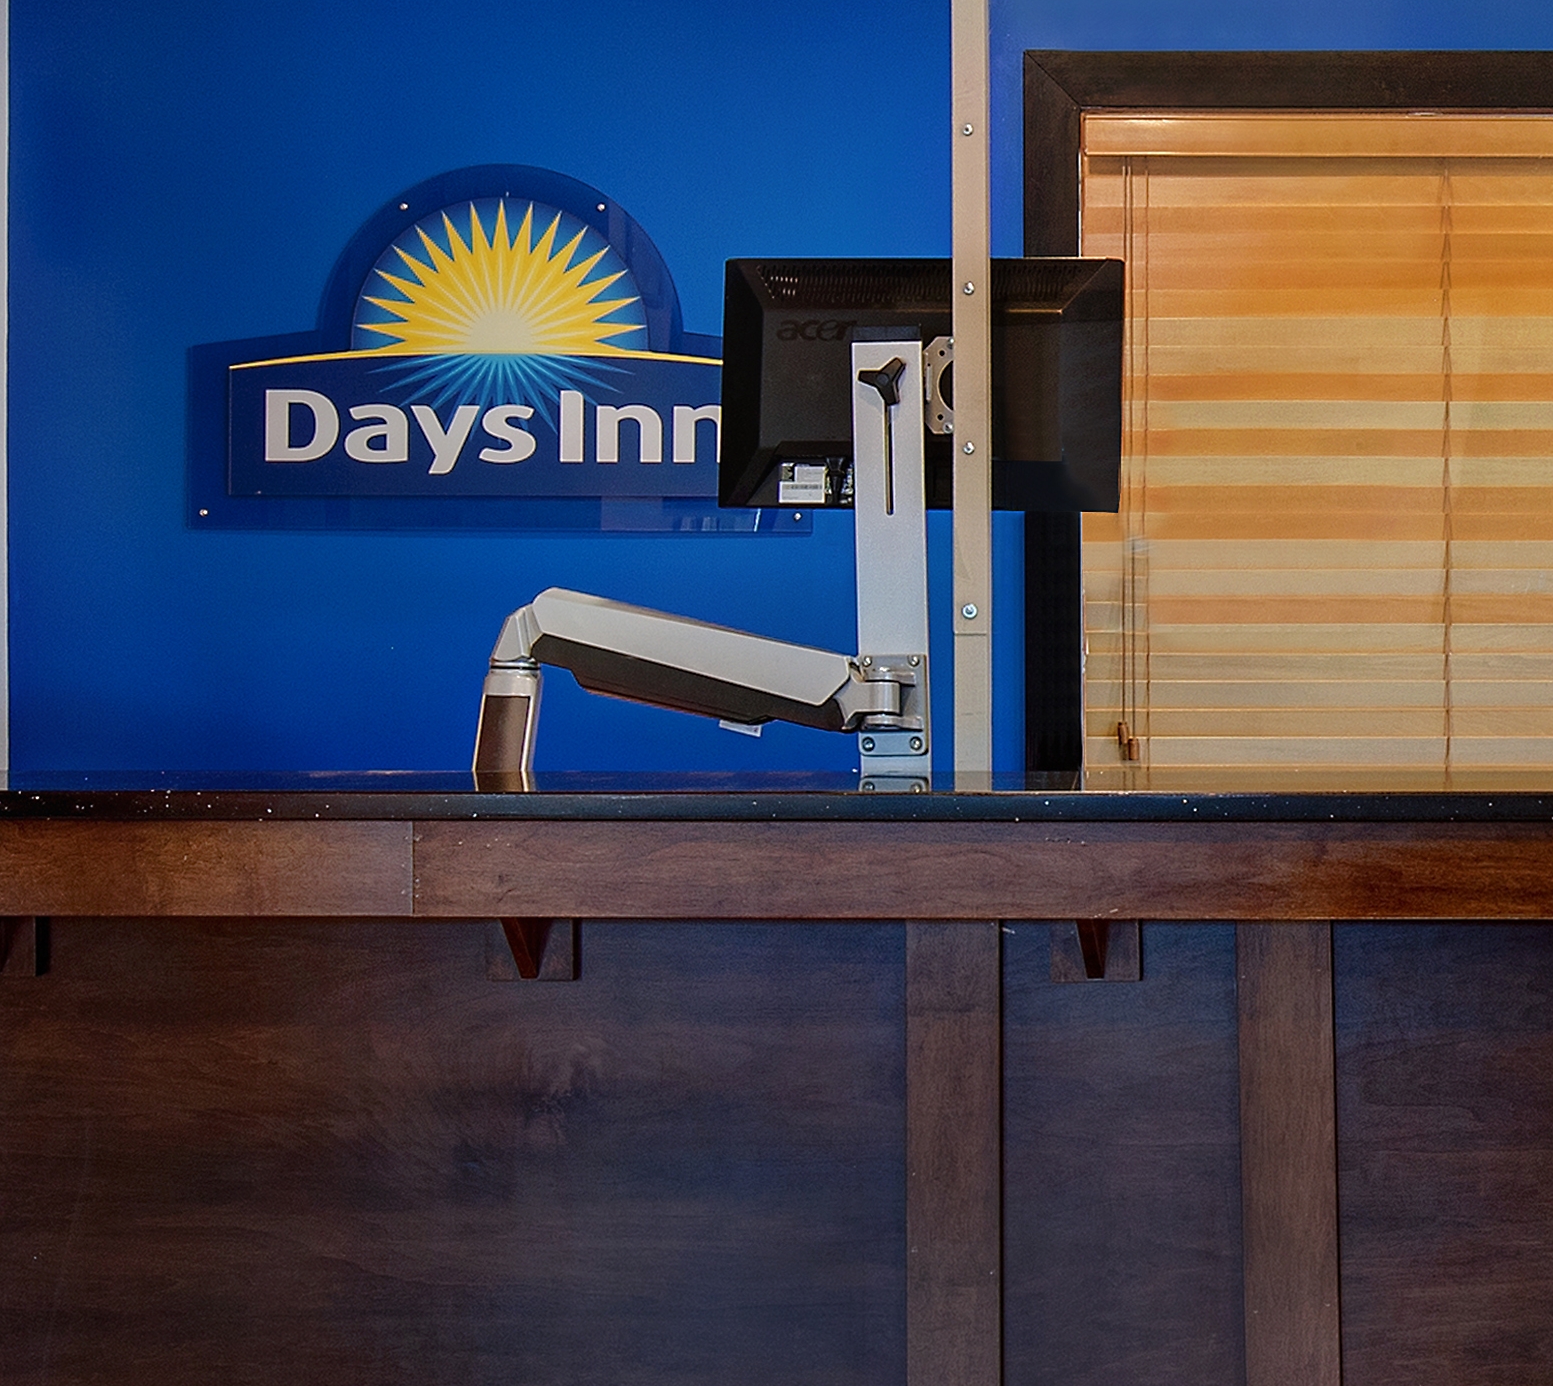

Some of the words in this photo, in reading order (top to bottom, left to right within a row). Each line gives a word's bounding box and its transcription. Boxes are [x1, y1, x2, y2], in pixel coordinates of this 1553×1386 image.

[776, 318, 856, 342] acer
[265, 389, 536, 476] Days
[561, 390, 722, 464] Inn
